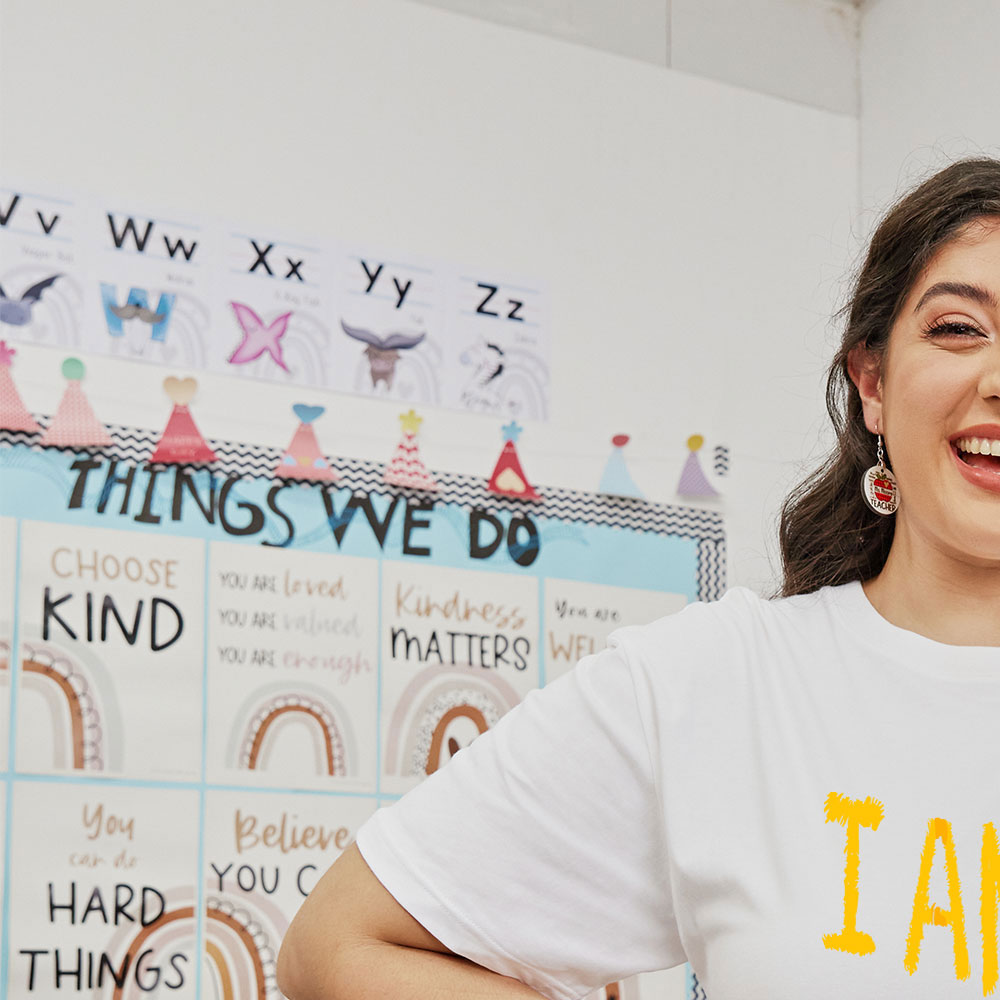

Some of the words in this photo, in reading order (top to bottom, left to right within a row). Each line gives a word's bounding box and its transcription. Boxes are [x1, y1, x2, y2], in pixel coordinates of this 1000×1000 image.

[68, 458, 294, 548] THINGS
[322, 486, 434, 557] WE
[469, 508, 540, 567] DO
[51, 548, 179, 589] CHOOSE
[219, 572, 249, 590] YOU
[284, 569, 346, 600] loved
[43, 586, 184, 651] KIND
[219, 609, 248, 629] YOU
[395, 581, 527, 630] Kindness
[218, 646, 248, 665] YOU
[82, 803, 135, 840] You
[234, 808, 350, 854] Believe
[211, 863, 279, 894] YOU
[822, 792, 884, 956] I
[48, 882, 165, 927] HARD
[19, 947, 188, 992] THINGS
